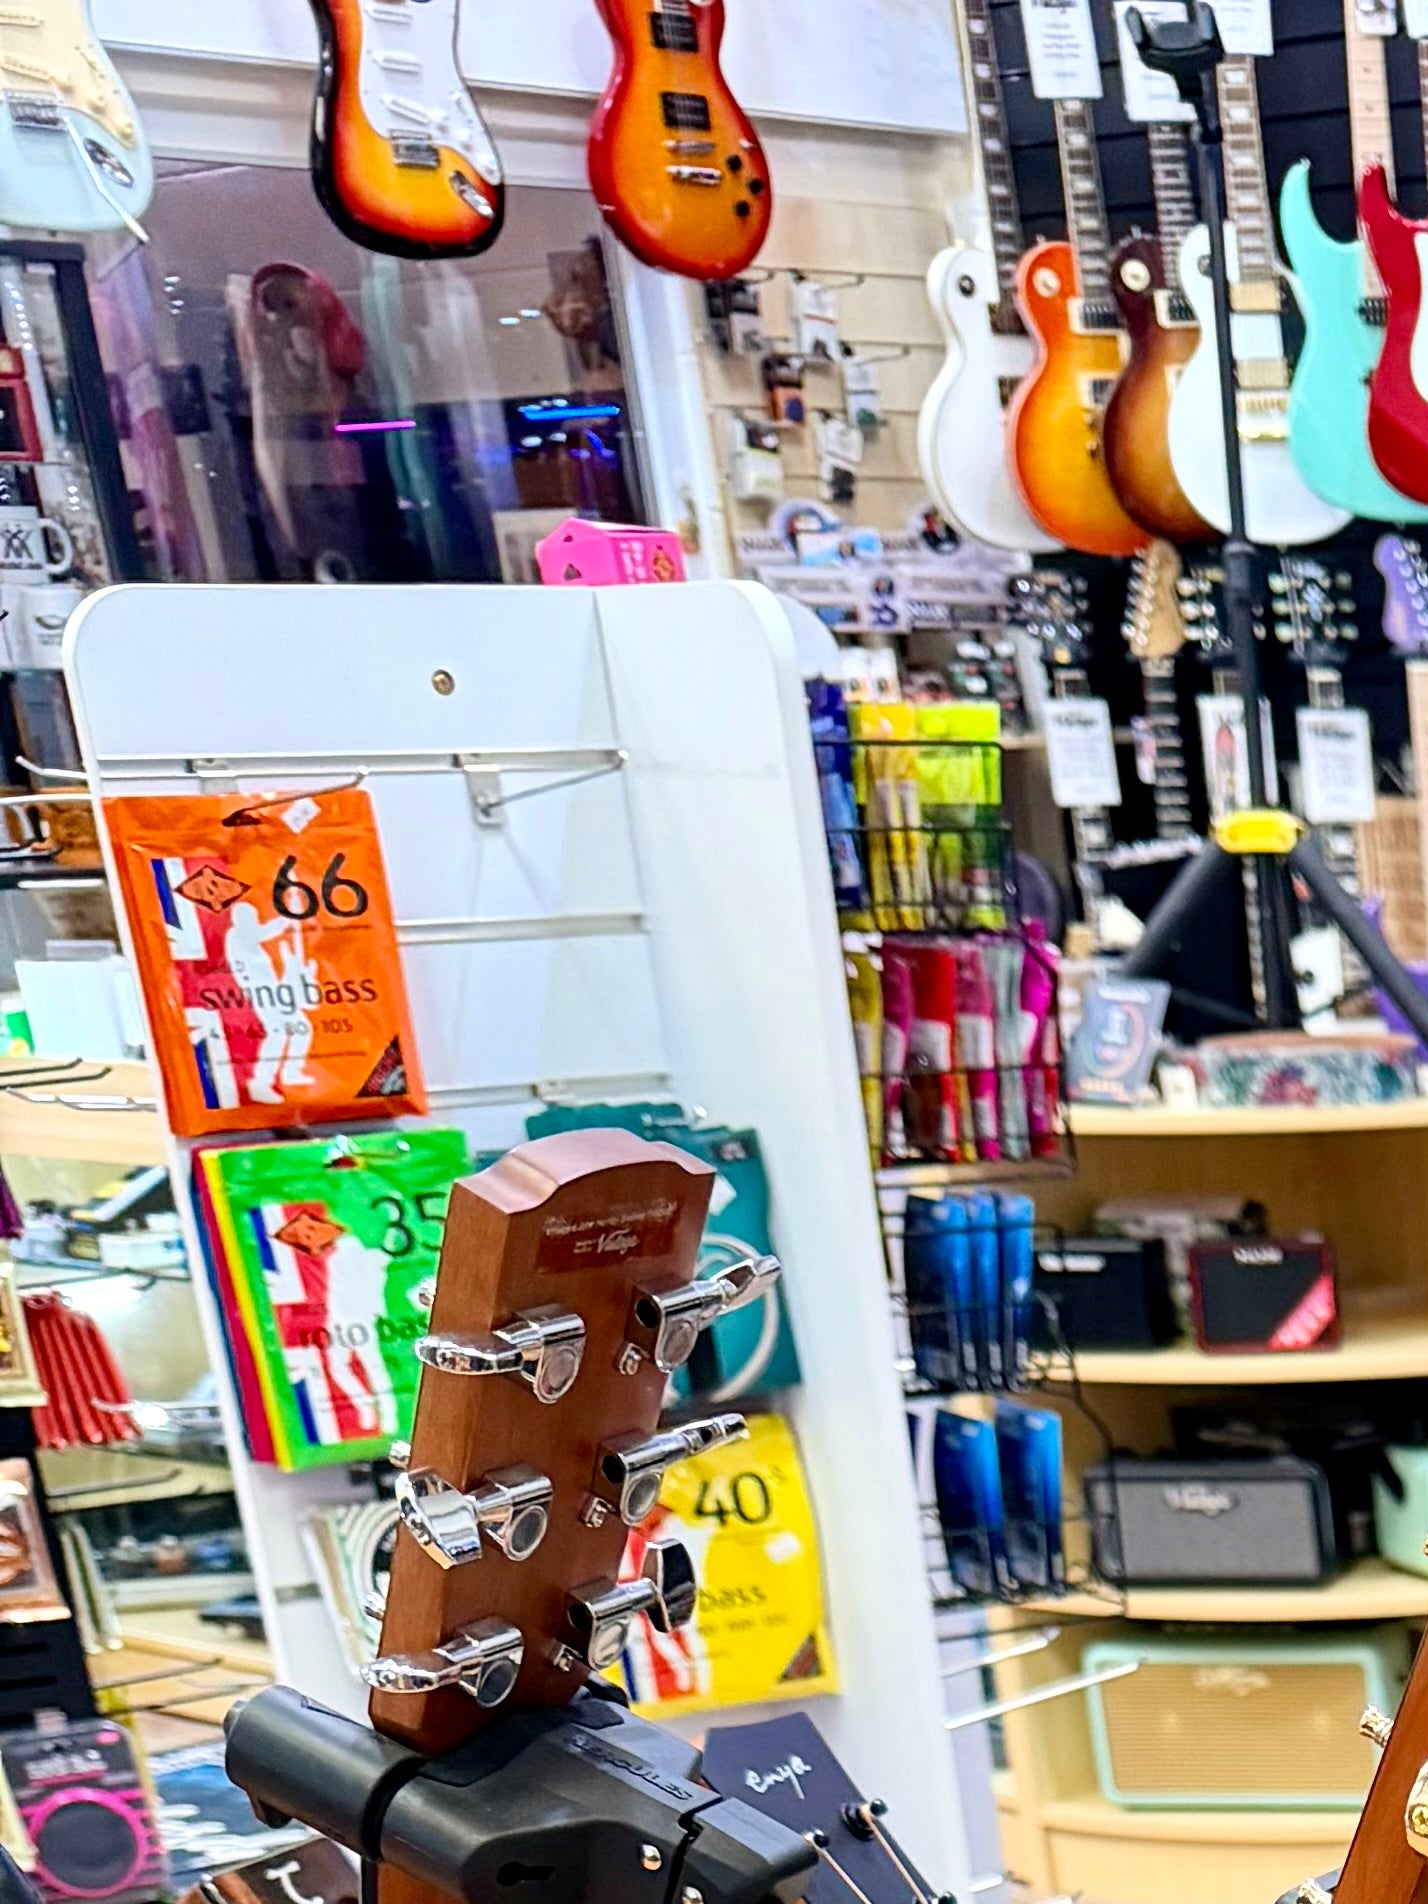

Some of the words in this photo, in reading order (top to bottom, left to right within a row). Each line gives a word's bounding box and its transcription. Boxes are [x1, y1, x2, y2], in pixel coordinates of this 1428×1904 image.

[272, 851, 369, 920] 66
[200, 983, 296, 1016] swing
[299, 973, 379, 1006] bass
[371, 1190, 447, 1257] 35
[744, 1754, 814, 1800] enya
